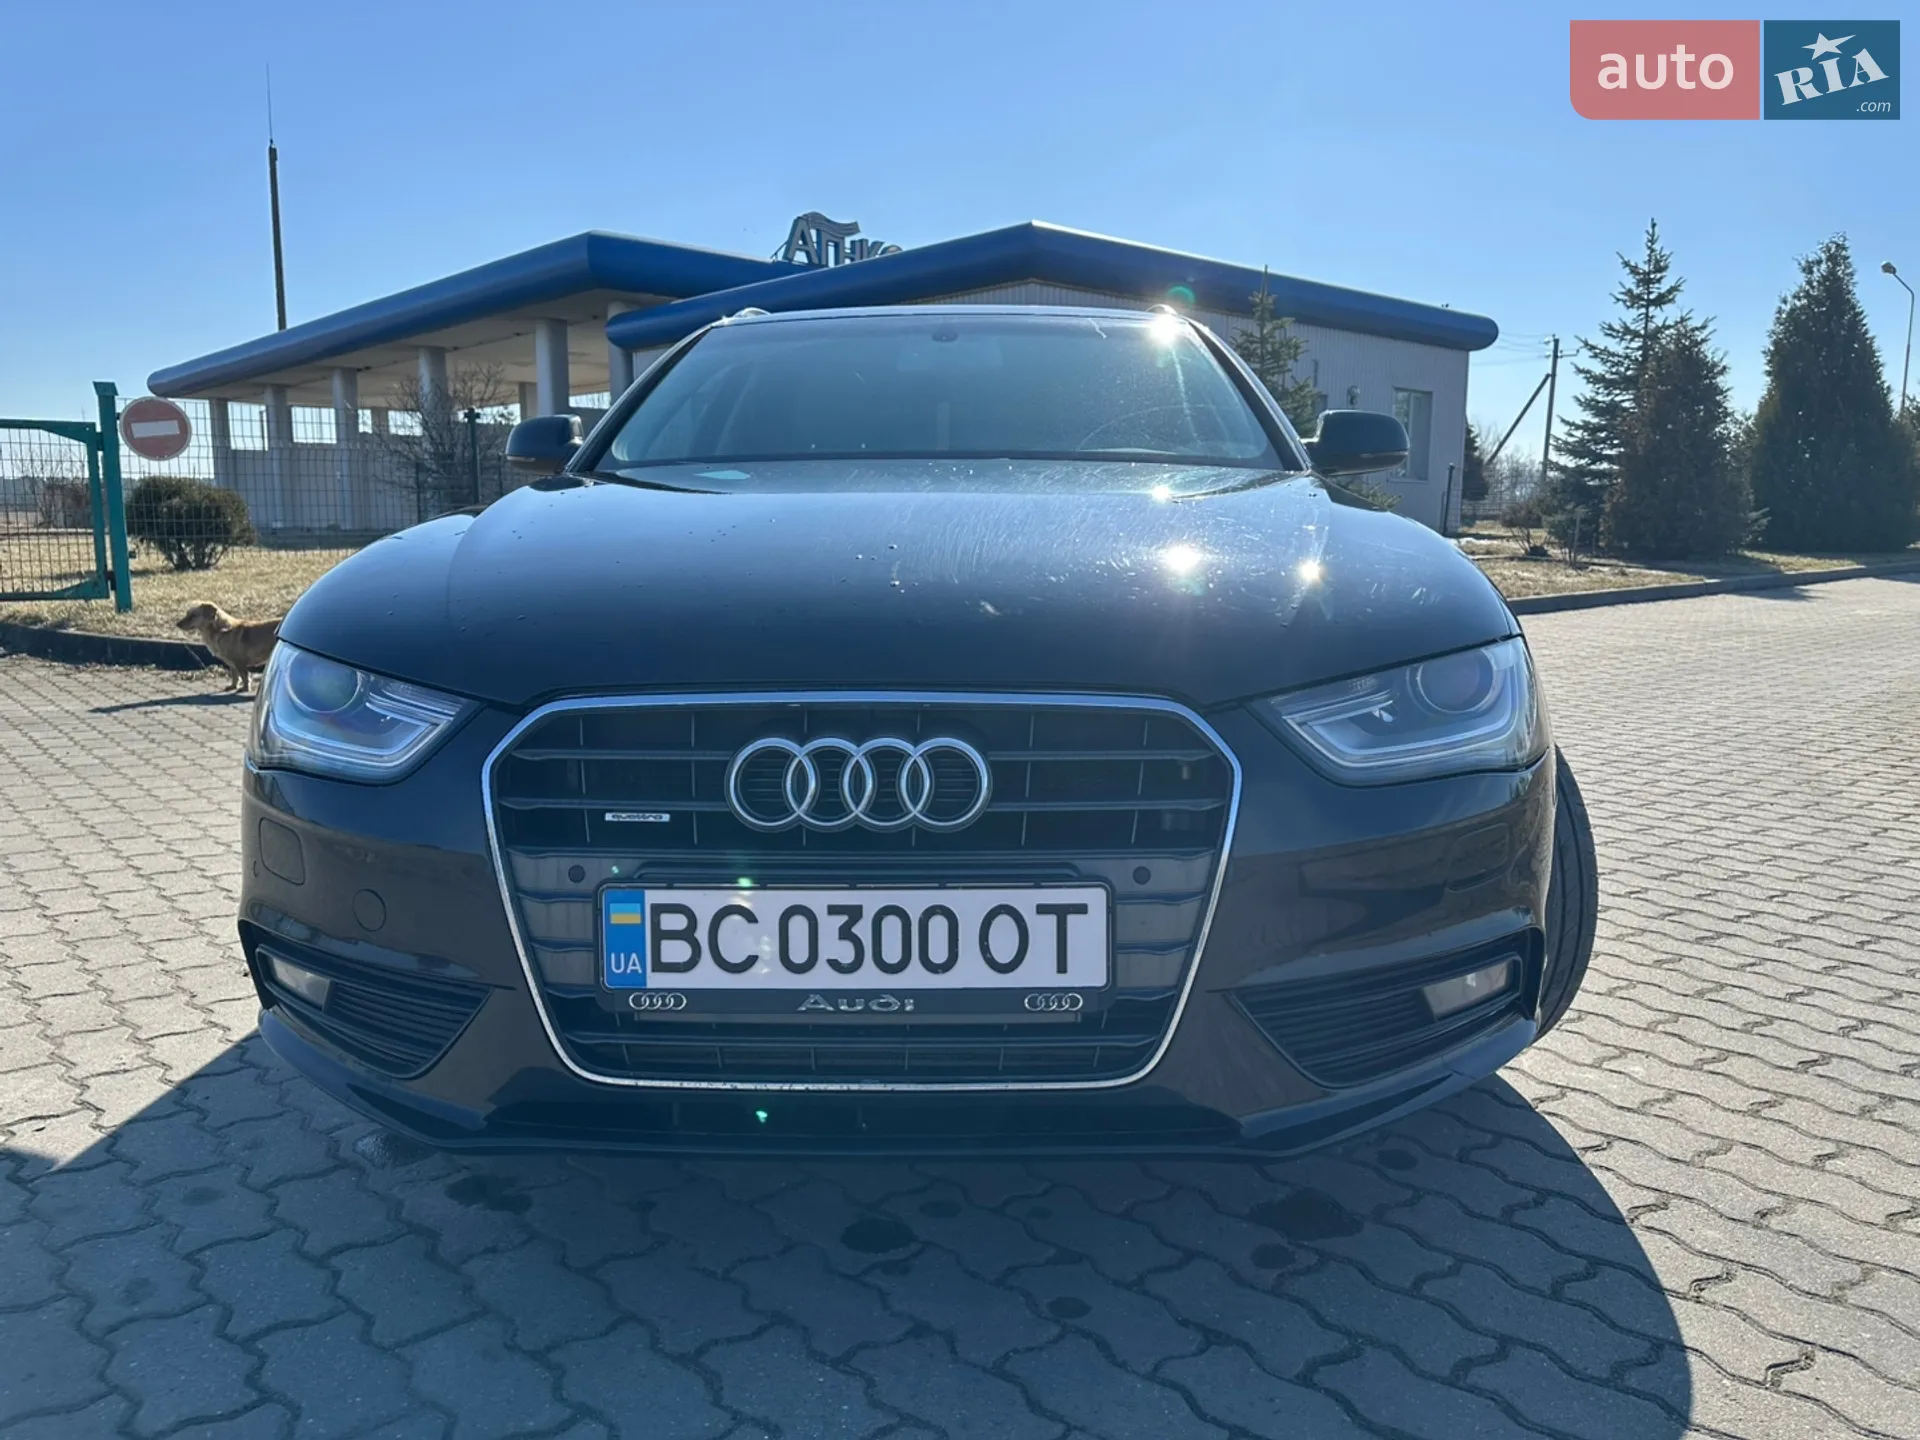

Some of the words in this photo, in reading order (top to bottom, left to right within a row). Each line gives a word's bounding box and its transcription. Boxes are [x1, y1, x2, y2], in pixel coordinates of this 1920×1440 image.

[609, 812, 665, 821] quattro
[650, 903, 760, 973] BC
[778, 903, 959, 975] 0300
[979, 903, 1088, 974] OT
[610, 952, 642, 974] UA
[797, 994, 915, 1011] Audi
